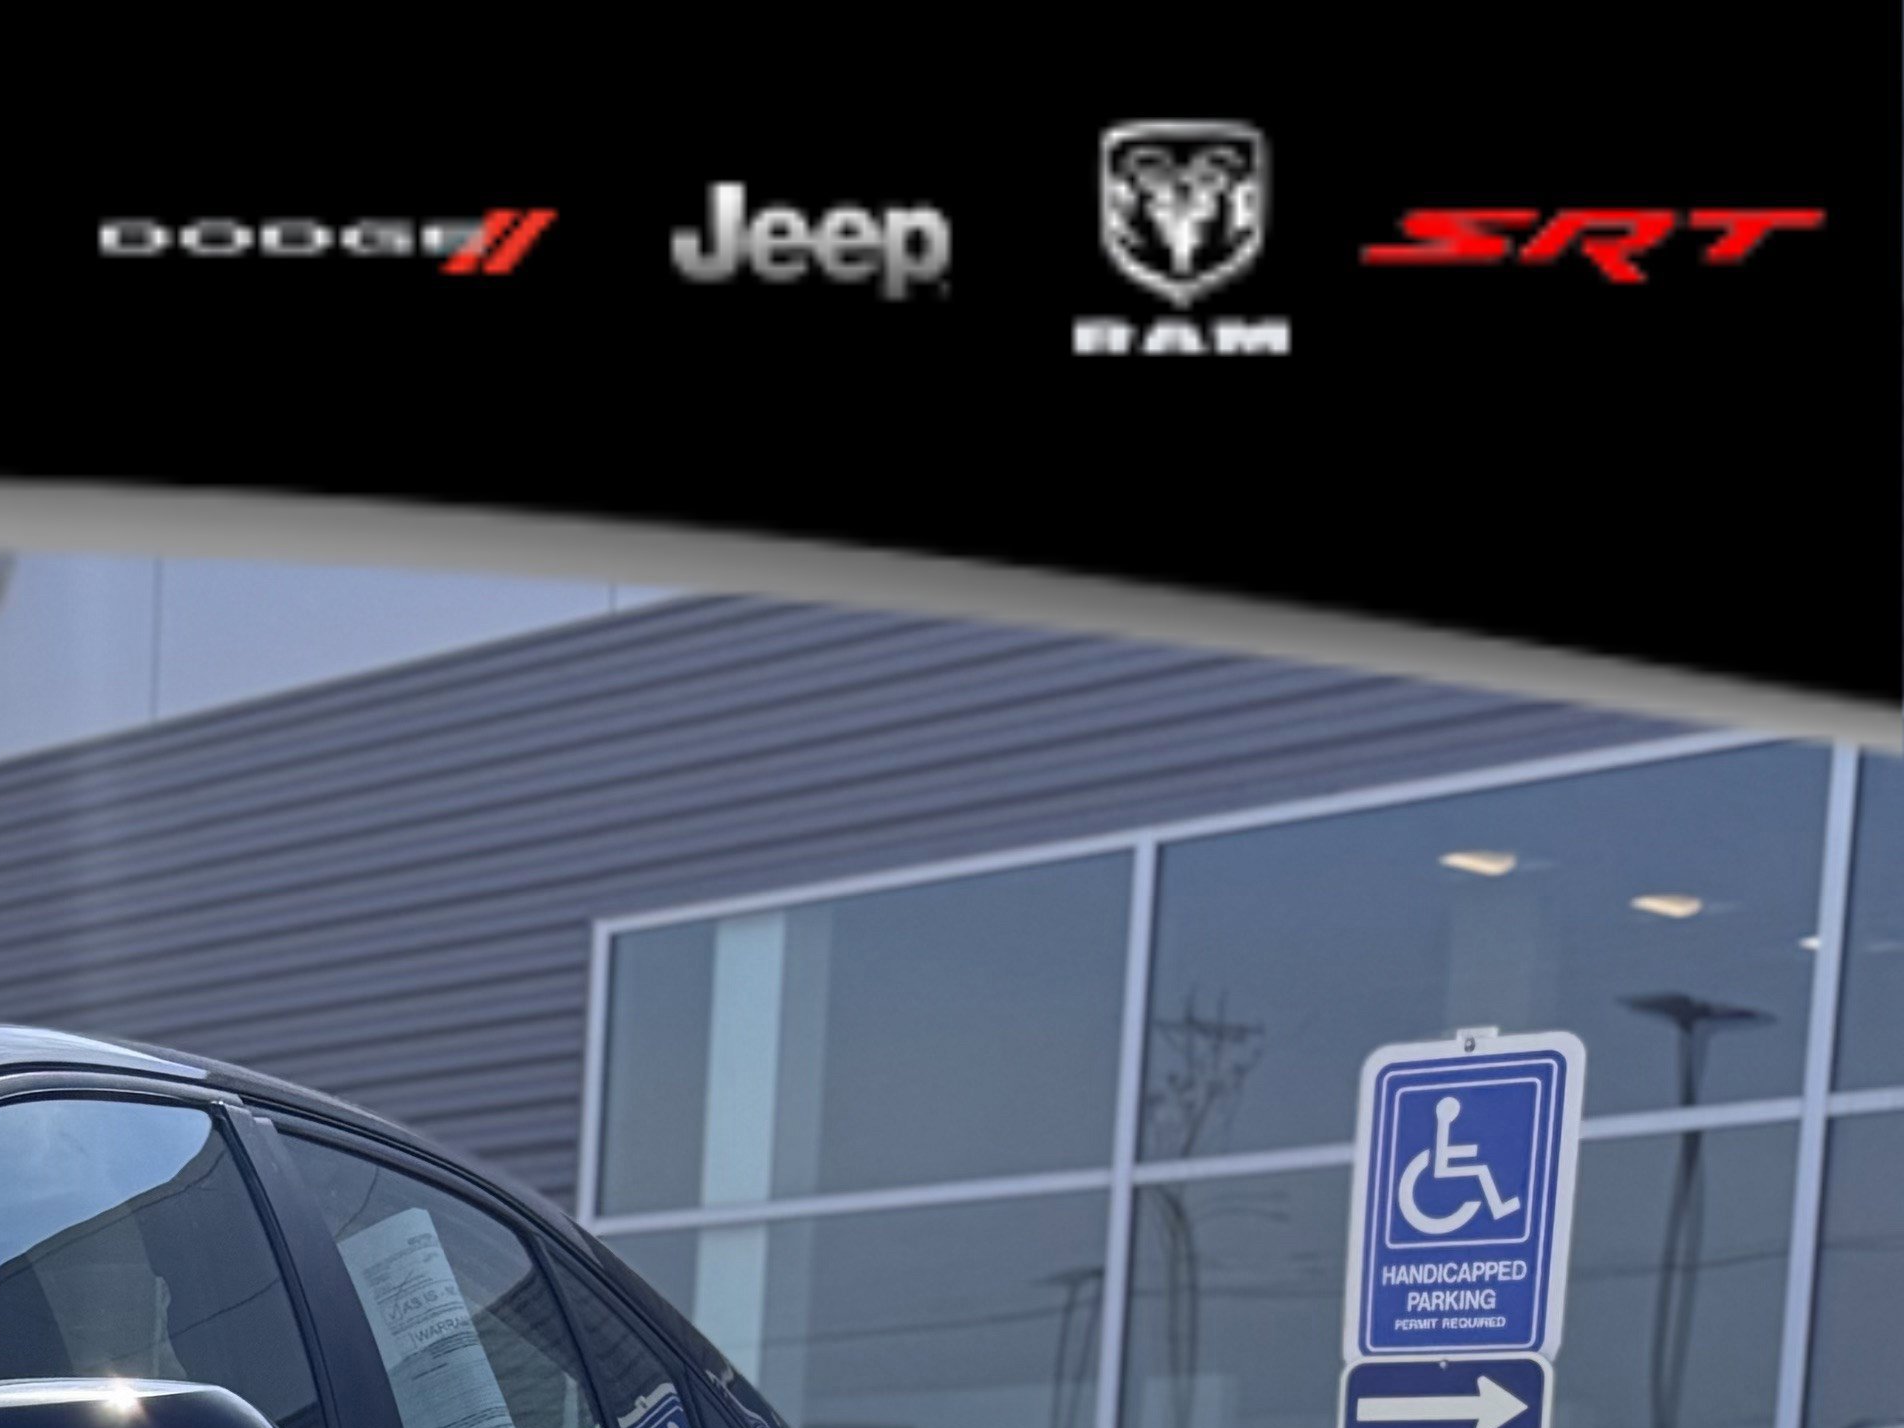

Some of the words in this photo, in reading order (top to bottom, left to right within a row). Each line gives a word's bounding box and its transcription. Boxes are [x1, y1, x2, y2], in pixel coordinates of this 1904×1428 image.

[1382, 1260, 1527, 1286] HANDICAPPED
[1407, 1289, 1496, 1312] PARKING
[1395, 1318, 1438, 1330] PERMIT
[1442, 1316, 1506, 1329] REQUIRED
